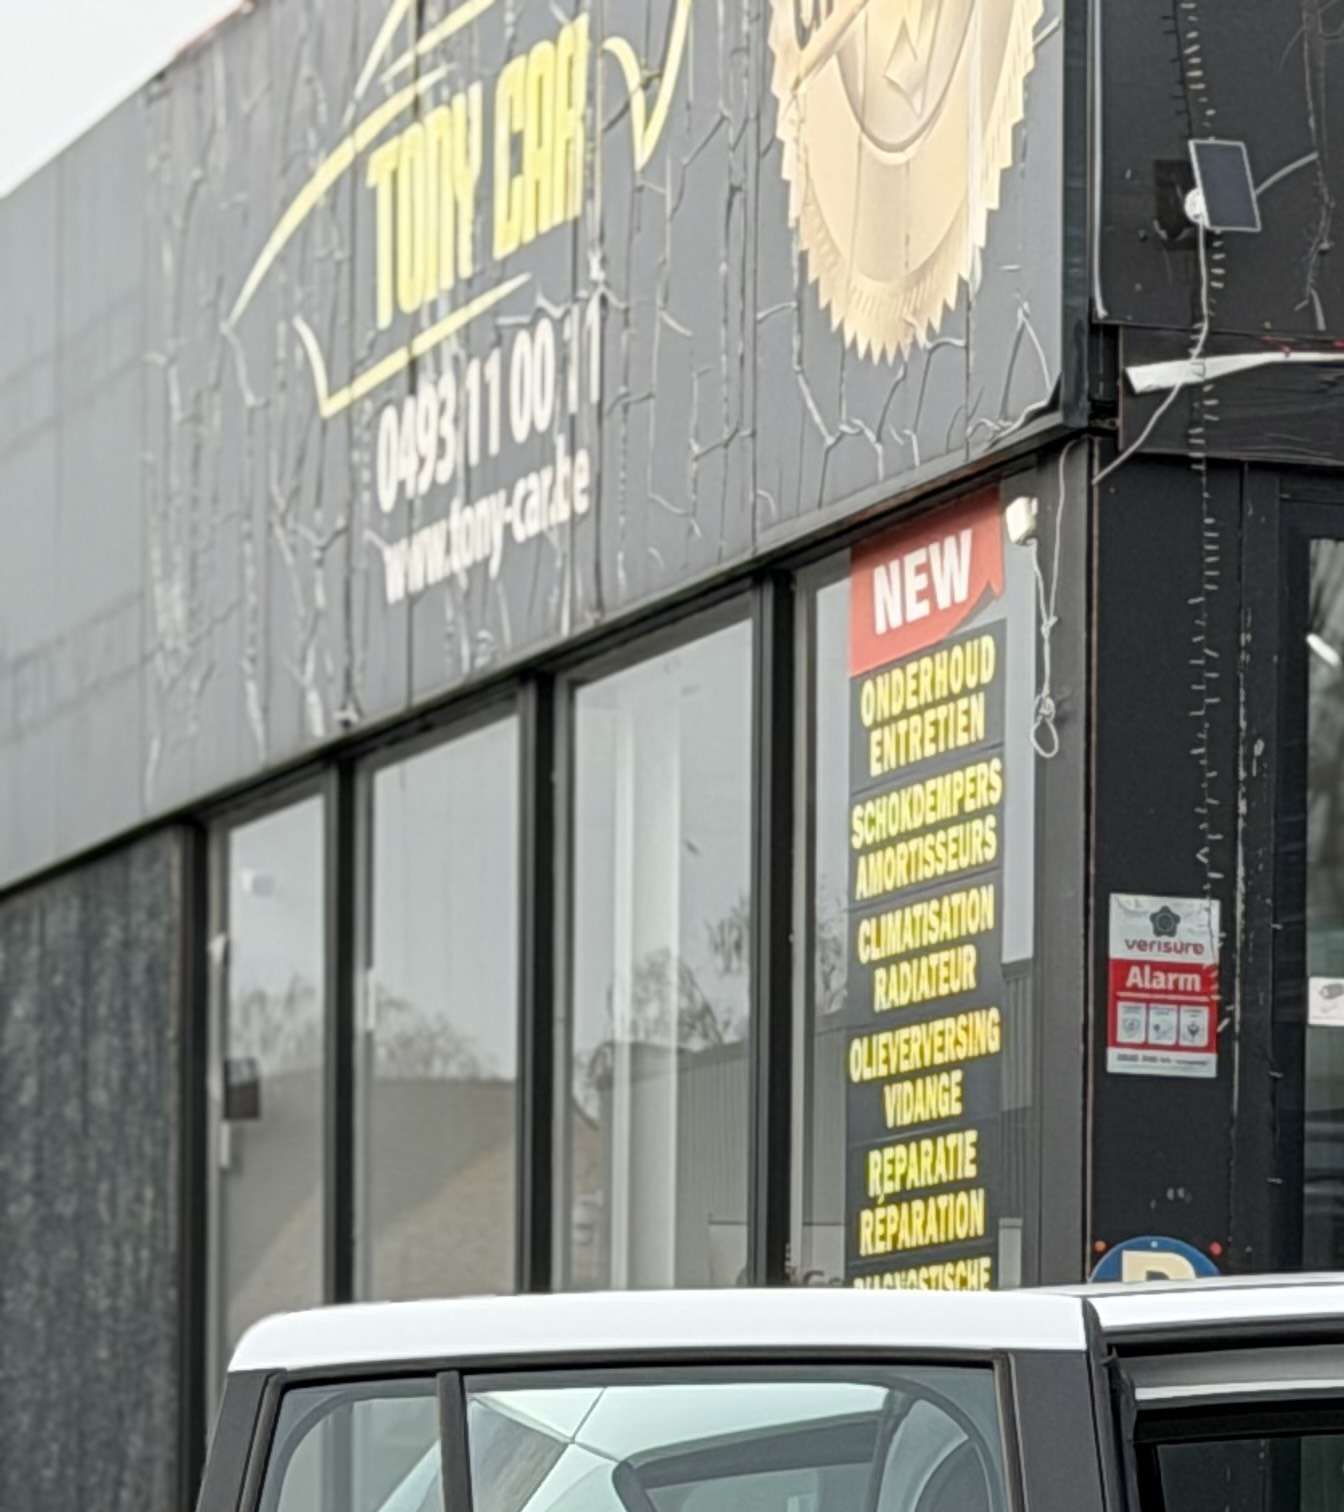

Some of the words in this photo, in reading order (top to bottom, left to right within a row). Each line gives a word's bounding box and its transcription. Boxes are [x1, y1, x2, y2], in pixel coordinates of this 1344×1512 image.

[367, 81, 483, 329] TONY
[492, 12, 590, 261] CAR
[509, 316, 556, 443] 00
[872, 529, 972, 634] NEW
[861, 635, 996, 727] ONDERHOUD
[869, 697, 985, 778] ENTRETIEN
[851, 757, 1003, 850] SCHOKDEMPERS
[855, 816, 997, 901] AMORTISSEURS
[857, 885, 995, 965] CLIMATISATION
[1125, 938, 1205, 955] verisure
[873, 945, 977, 1014] RADIATEUR
[1125, 965, 1201, 991] Alarm
[849, 1008, 1000, 1084] OLIEVERVERSING
[883, 1069, 963, 1129] VIDANGE
[868, 1130, 978, 1198] REPARATIE
[859, 1188, 985, 1257] RÉPARATION
